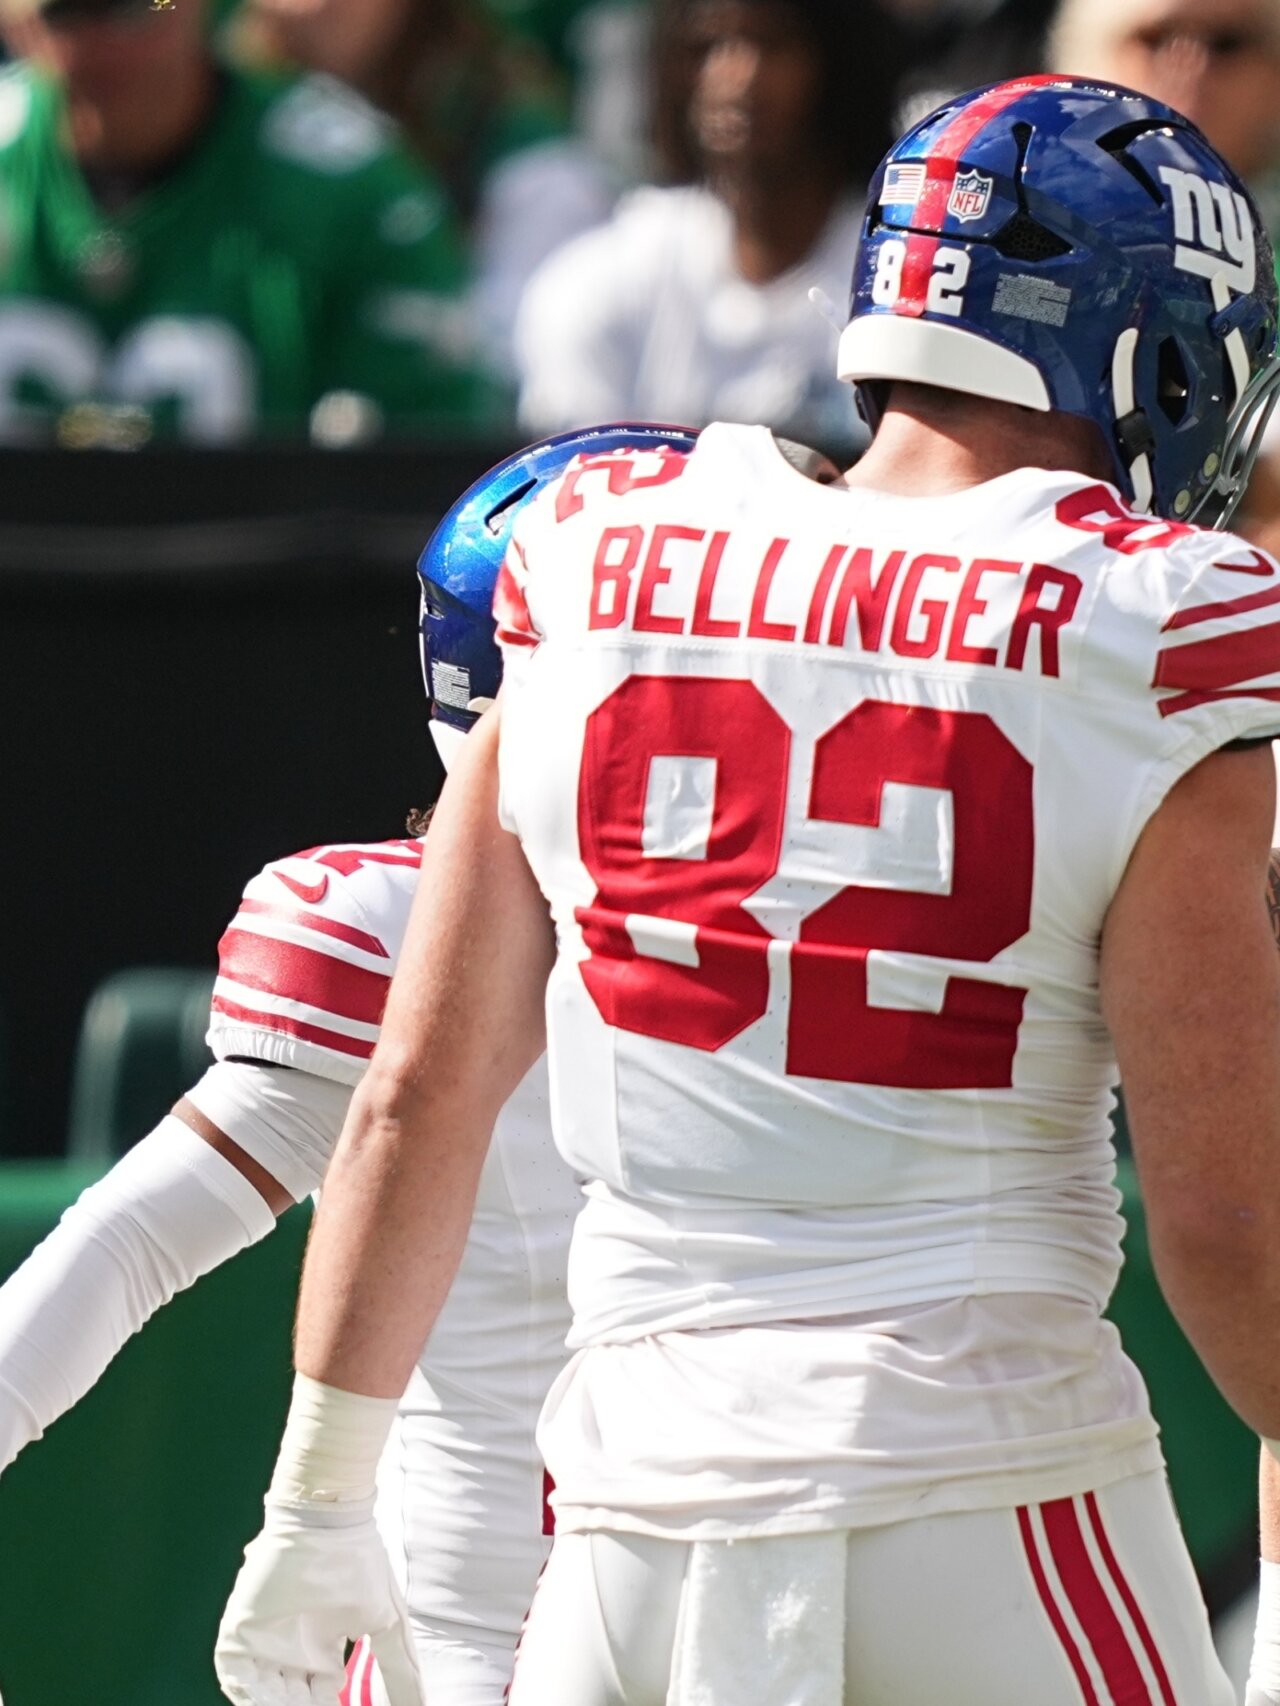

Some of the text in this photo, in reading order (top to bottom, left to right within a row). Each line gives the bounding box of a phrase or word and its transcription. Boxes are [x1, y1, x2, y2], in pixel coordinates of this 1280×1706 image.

[953, 191, 981, 214] NFL
[1158, 165, 1256, 294] ny
[872, 239, 971, 318] 82
[588, 523, 1084, 679] BELLINGER
[576, 674, 1036, 1090] 82
